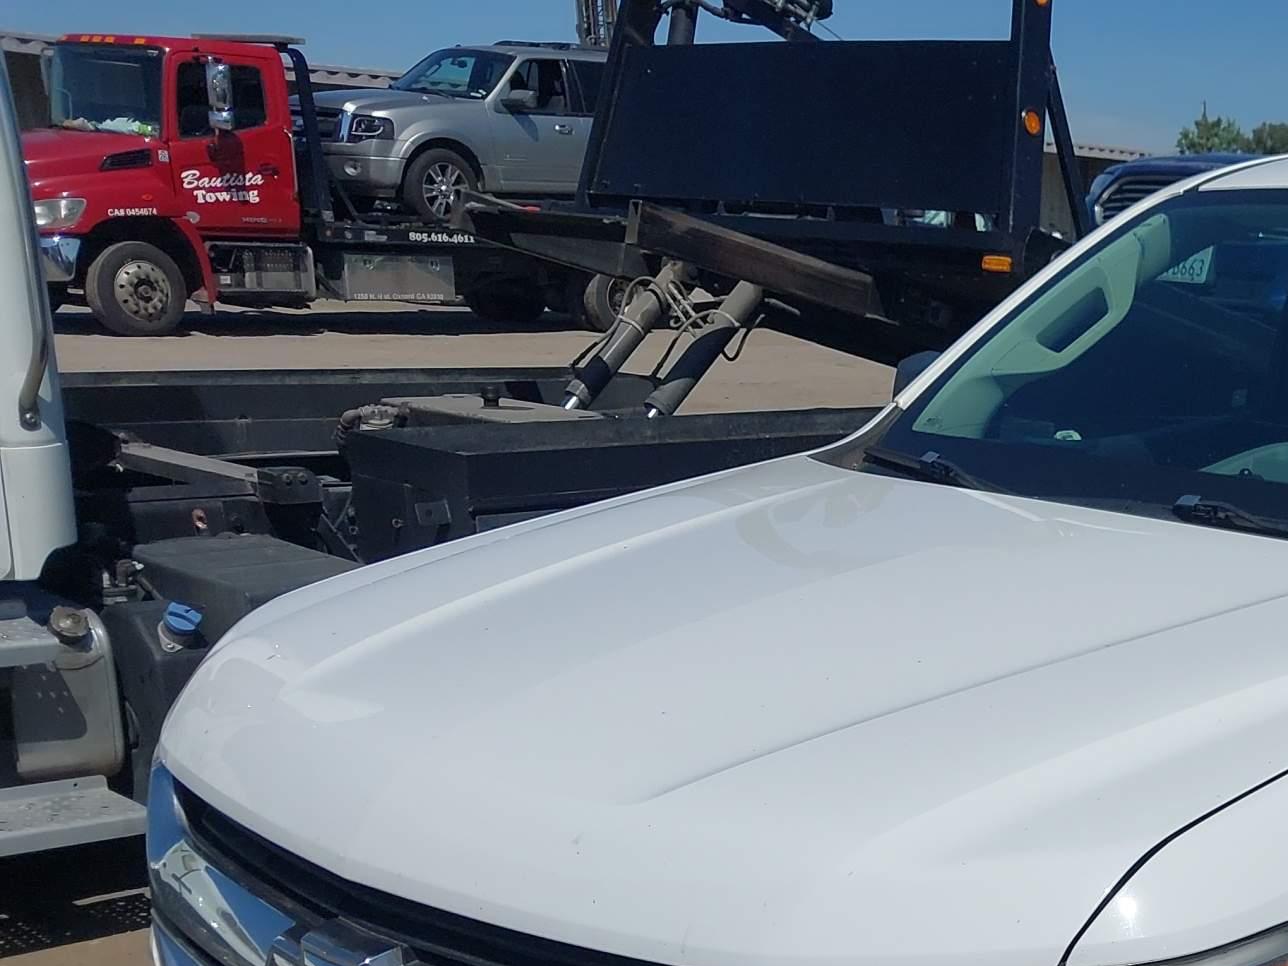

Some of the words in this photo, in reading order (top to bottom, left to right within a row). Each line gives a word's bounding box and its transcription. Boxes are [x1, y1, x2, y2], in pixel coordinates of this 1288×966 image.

[181, 170, 264, 189] Bautista
[193, 189, 260, 203] Towing
[408, 231, 475, 244] 805.616.4611
